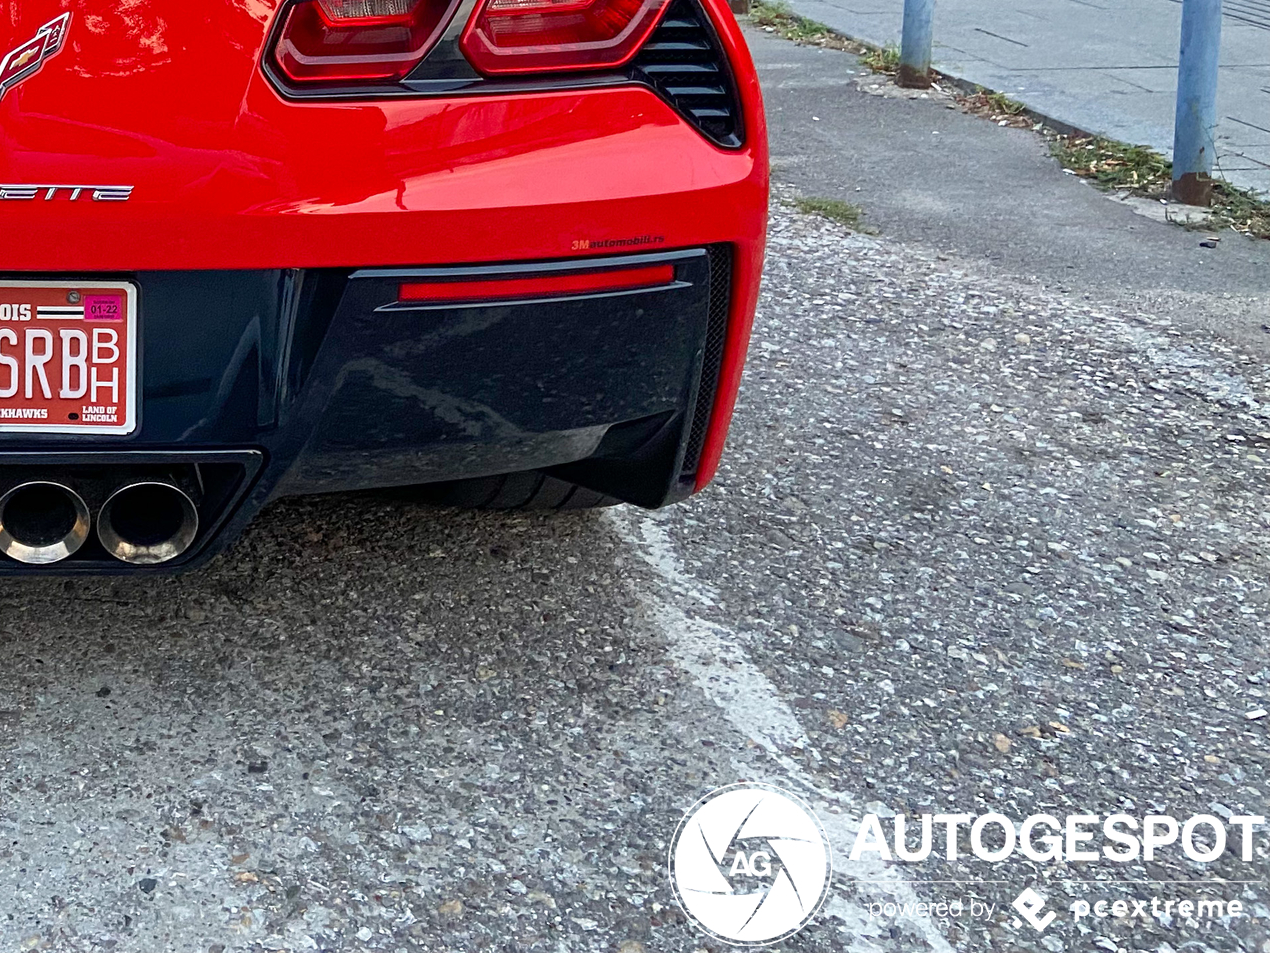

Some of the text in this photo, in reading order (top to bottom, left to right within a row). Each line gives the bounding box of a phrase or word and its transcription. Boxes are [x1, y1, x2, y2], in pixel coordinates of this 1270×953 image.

[91, 305, 118, 314] 01-22
[82, 406, 117, 414] LAND OF
[82, 414, 117, 423] LINCOLN
